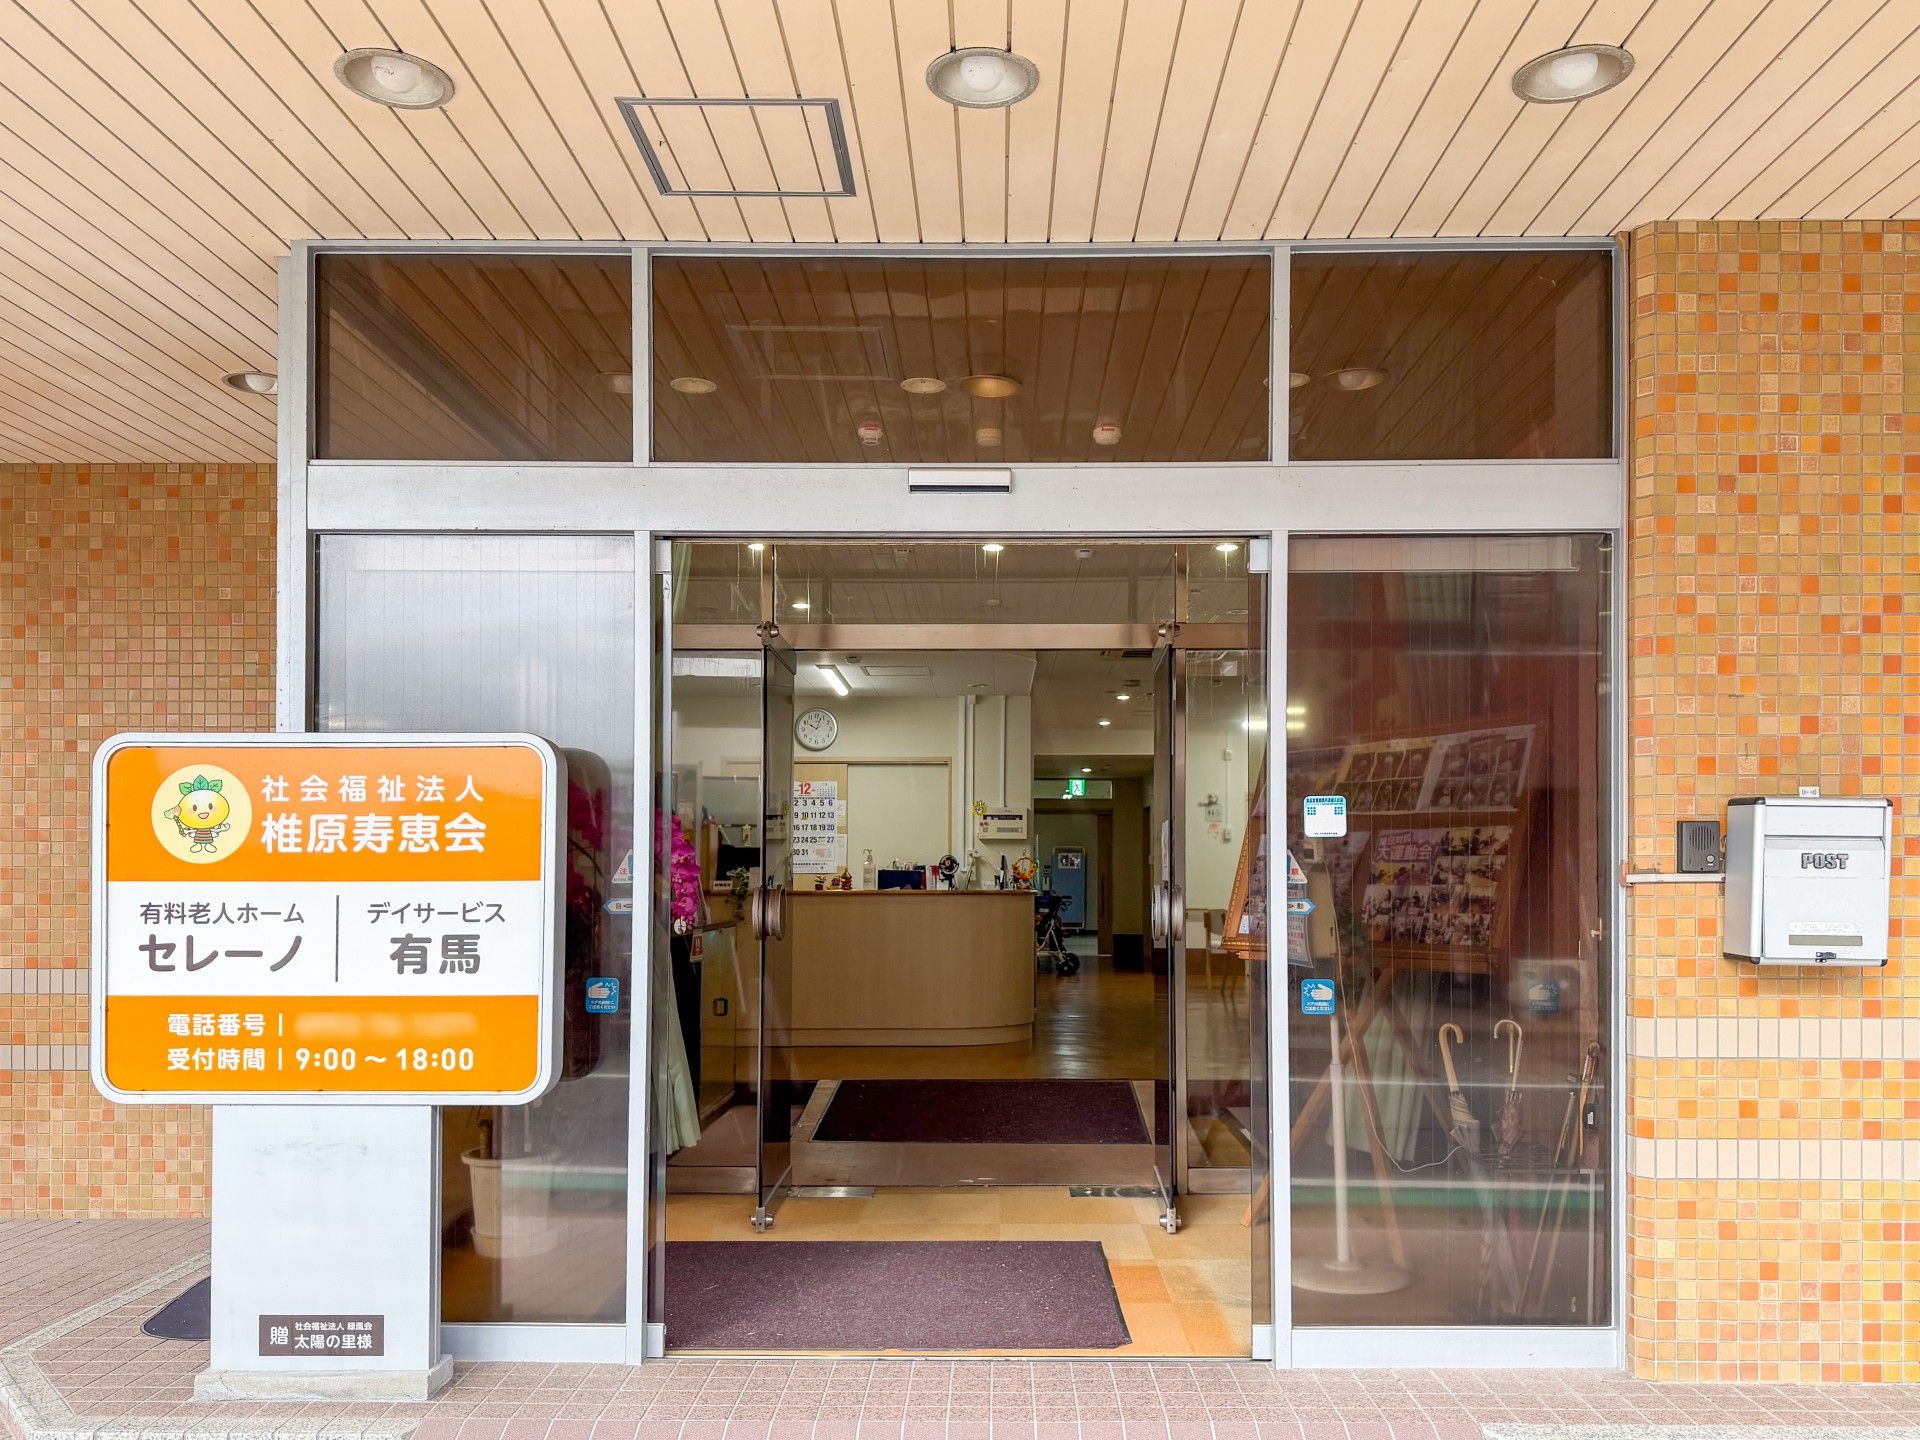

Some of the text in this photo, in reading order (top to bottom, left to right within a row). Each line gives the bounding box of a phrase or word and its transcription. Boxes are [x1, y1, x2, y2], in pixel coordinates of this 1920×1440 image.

[263, 775, 482, 802] 社会福祉法人
[798, 783, 812, 795] 12
[262, 812, 486, 853] 椎原寿恵会
[801, 848, 809, 856] 31
[1800, 852, 1850, 870] POST
[619, 867, 628, 875] 注
[139, 901, 305, 925] 有料老人ホーム
[367, 900, 506, 924] デイサービス
[138, 933, 303, 972] セレーノ
[389, 932, 482, 975] 有馬
[168, 1013, 265, 1036] 電話番号
[168, 1047, 265, 1071] 受付時間
[270, 1326, 288, 1345] 贈
[295, 1322, 344, 1331] 社会福祉法人
[295, 1334, 372, 1349] 太陽の里様
